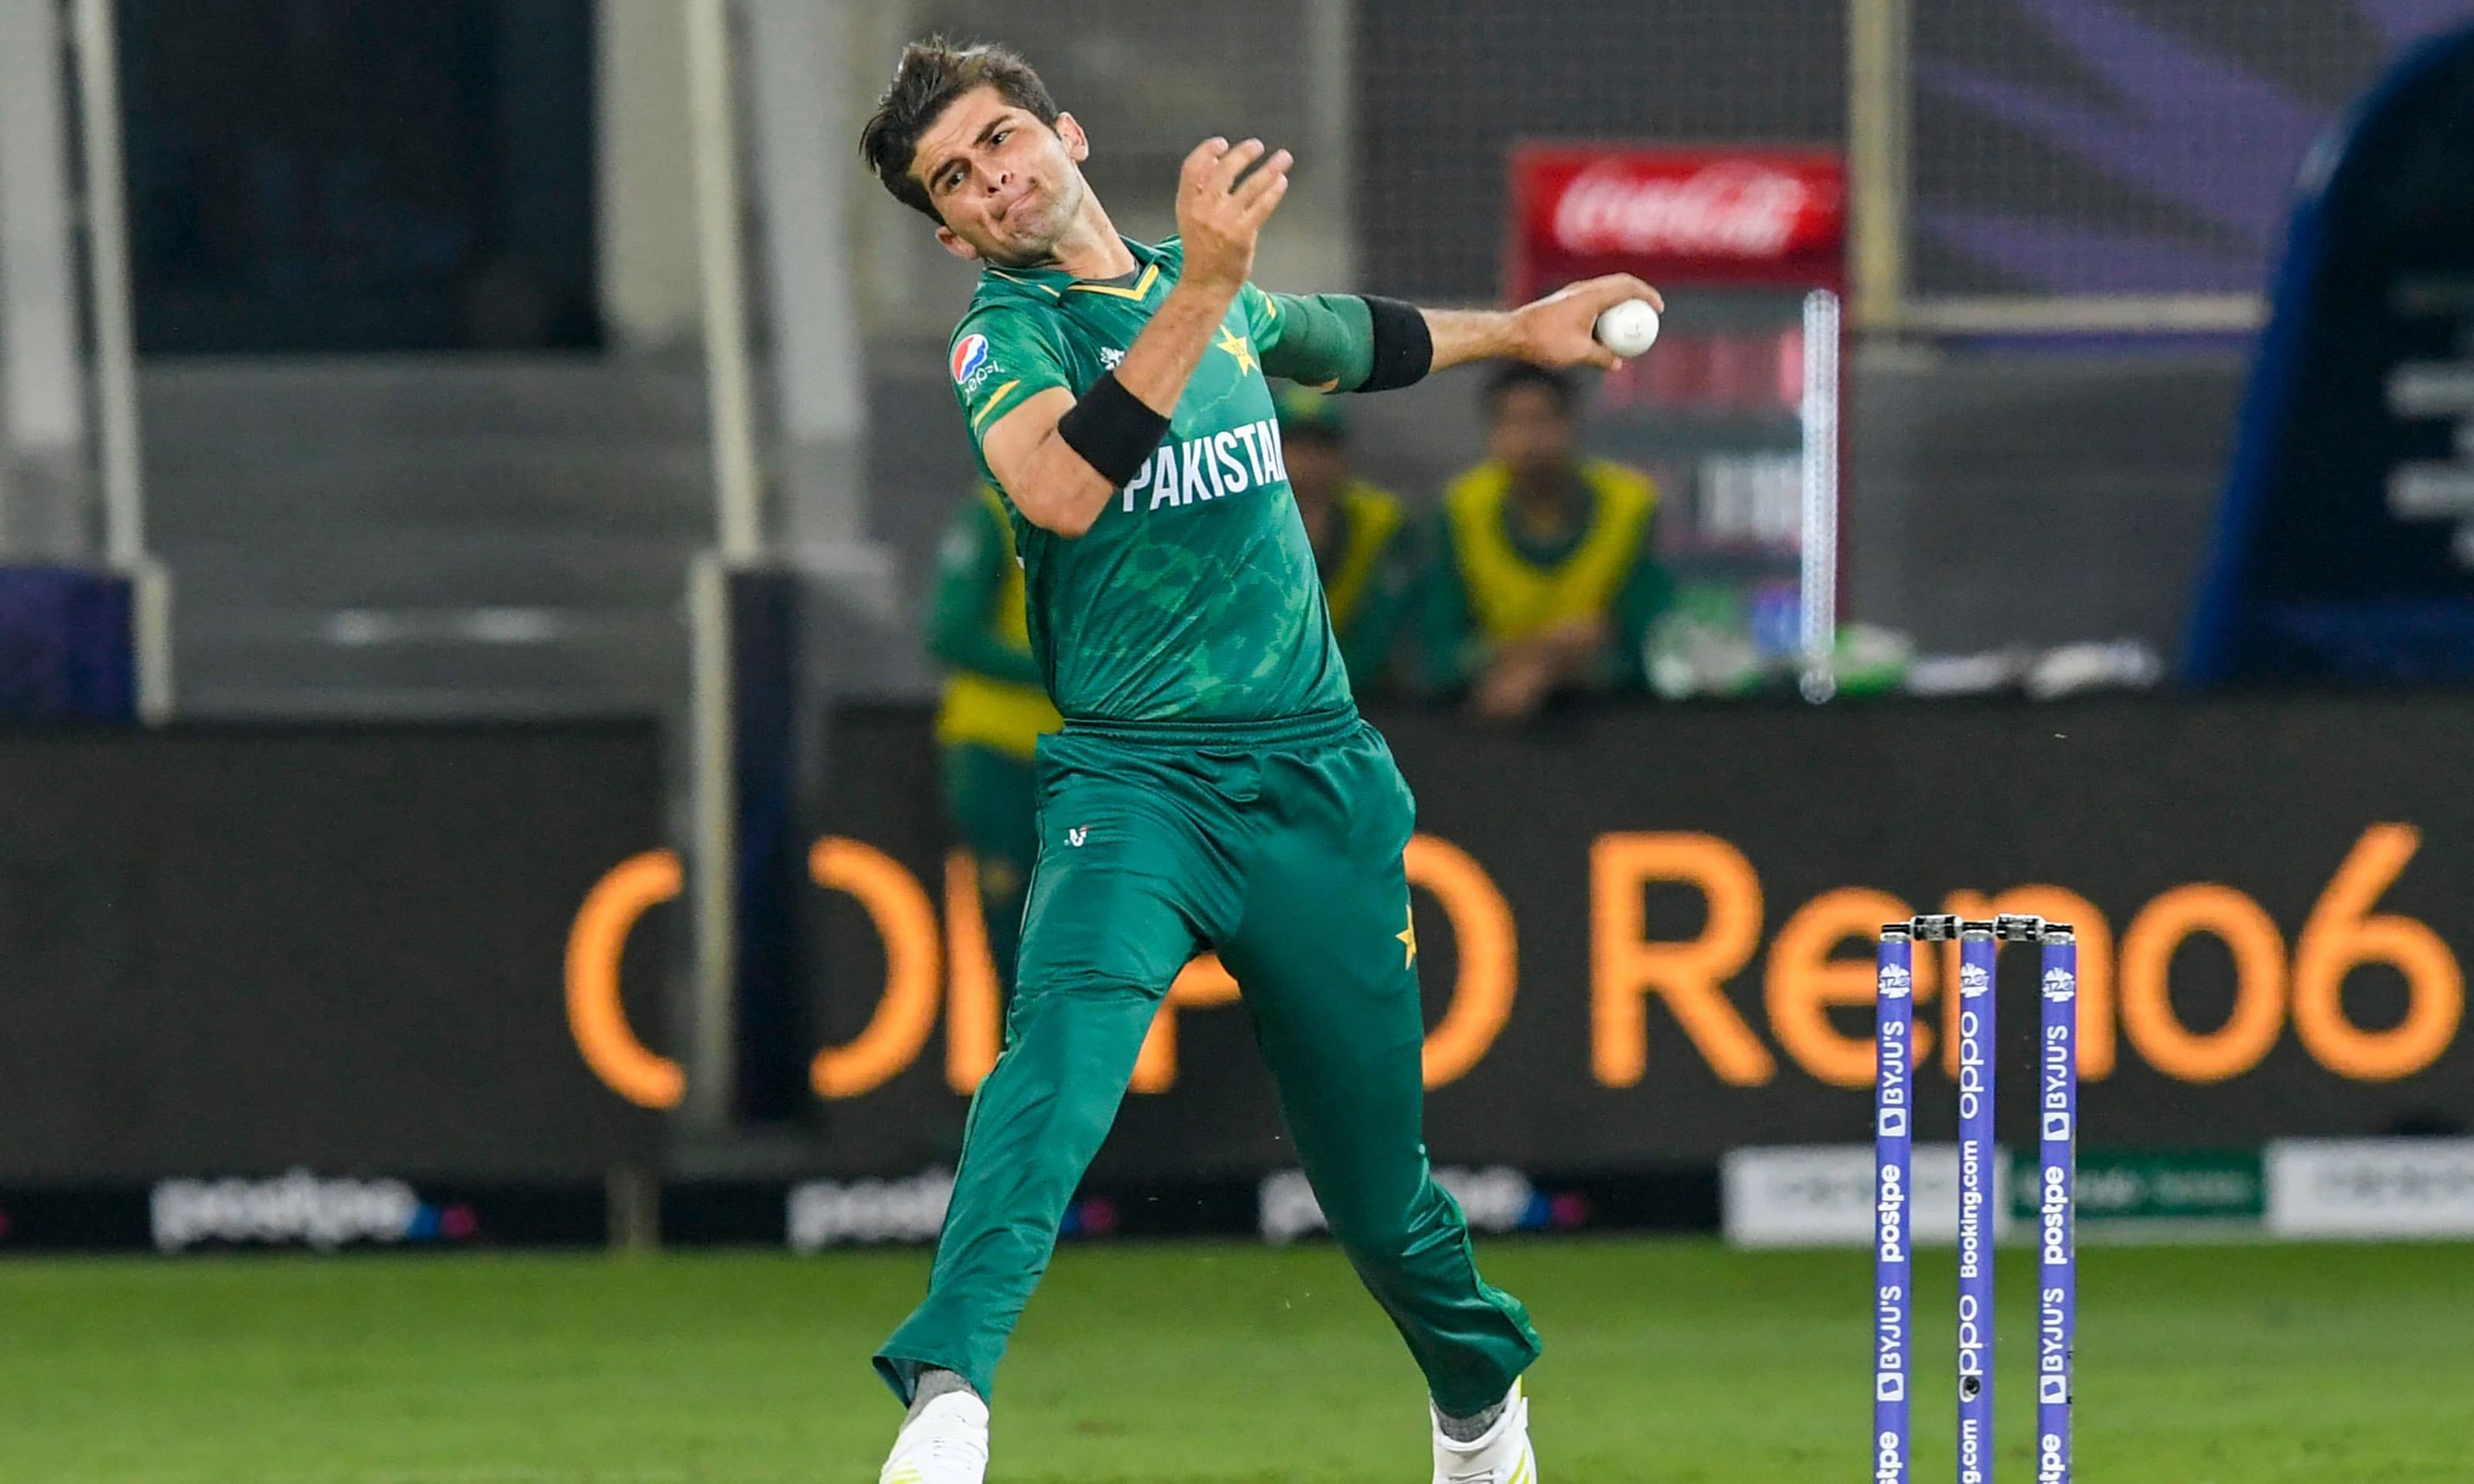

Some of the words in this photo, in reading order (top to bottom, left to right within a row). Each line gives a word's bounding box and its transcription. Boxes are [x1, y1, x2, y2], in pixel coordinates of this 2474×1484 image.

[1590, 821, 2465, 1087] Reno6
[1882, 1020, 1904, 1104] BYJU'S
[1960, 1011, 1985, 1119] oppo
[2046, 1025, 2068, 1108] BYJU'S
[1877, 1164, 1905, 1263] postpe
[1961, 1140, 1982, 1278] Booking.com
[2042, 1166, 2069, 1264] postpe
[1879, 1285, 1902, 1369] BYJU'S
[2042, 1288, 2064, 1372] BYJU'S
